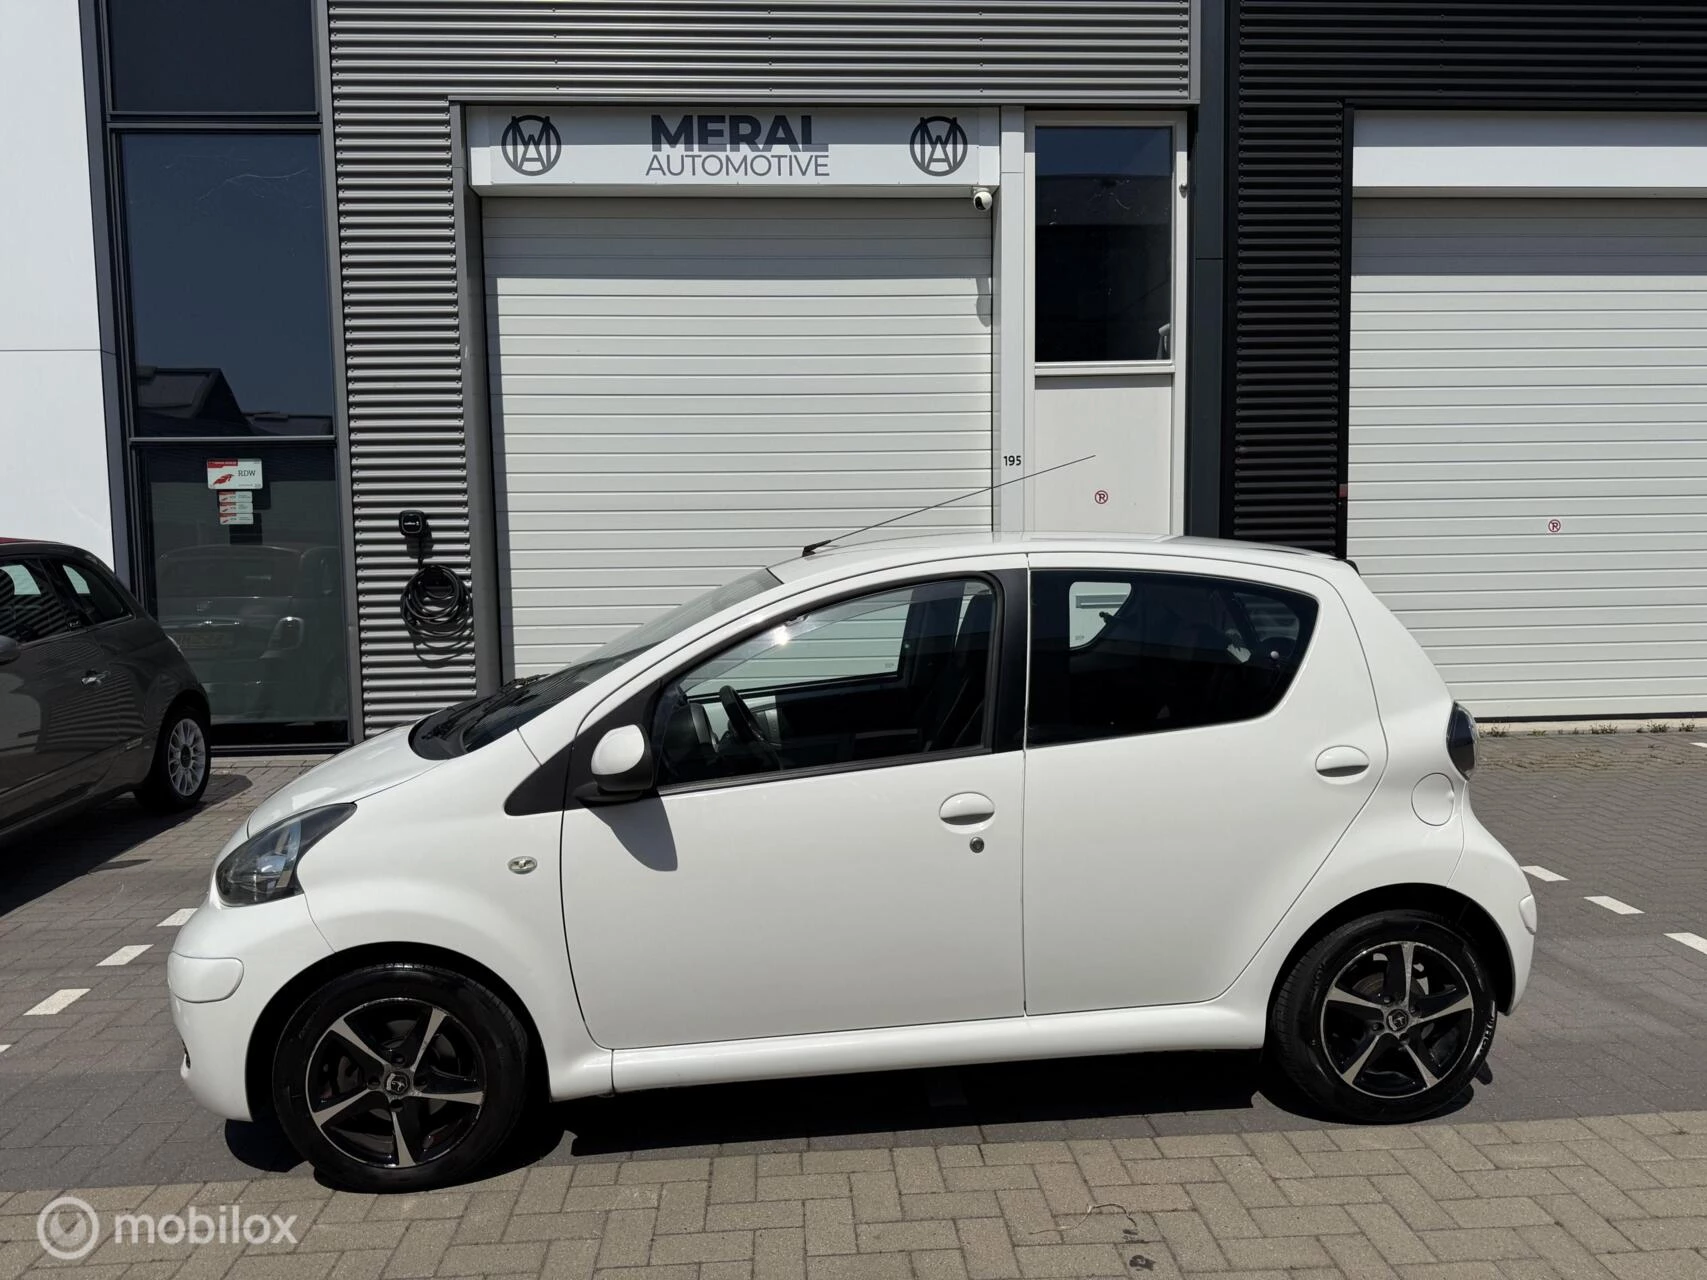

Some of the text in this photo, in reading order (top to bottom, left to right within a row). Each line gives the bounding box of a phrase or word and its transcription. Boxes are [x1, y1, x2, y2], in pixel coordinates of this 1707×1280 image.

[651, 115, 829, 152] MERAL
[646, 154, 830, 176] AUTOMOTIVE
[1003, 455, 1022, 466] 195
